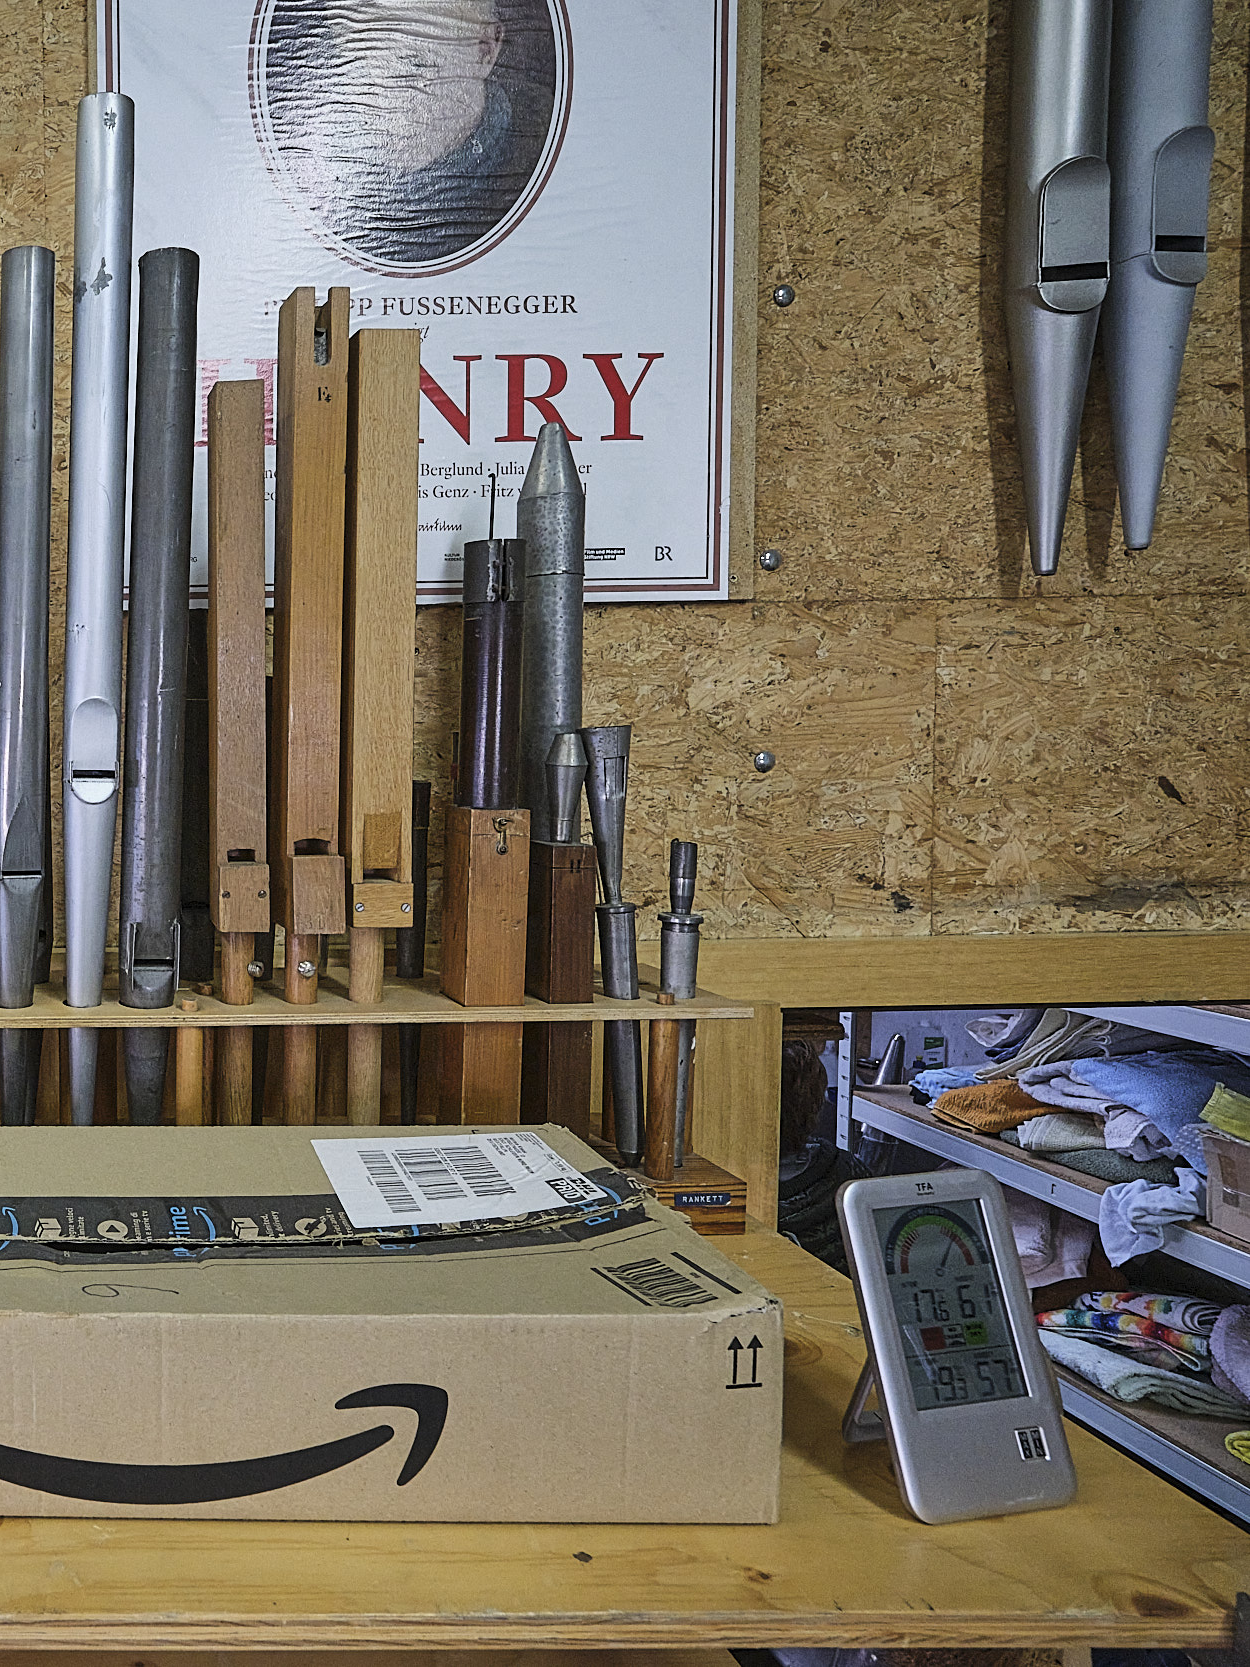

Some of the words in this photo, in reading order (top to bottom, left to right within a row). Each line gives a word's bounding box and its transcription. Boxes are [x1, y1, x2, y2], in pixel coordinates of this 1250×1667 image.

[381, 294, 578, 316] FUSSENEGGER
[420, 462, 484, 480] Berglund
[495, 461, 525, 478] Julia
[432, 485, 470, 499] Genz
[480, 483, 515, 498] Fitz
[654, 545, 673, 561] BR
[550, 1178, 584, 1201] PRIO
[915, 1182, 934, 1192] TFA
[682, 1195, 724, 1204] RANKETT
